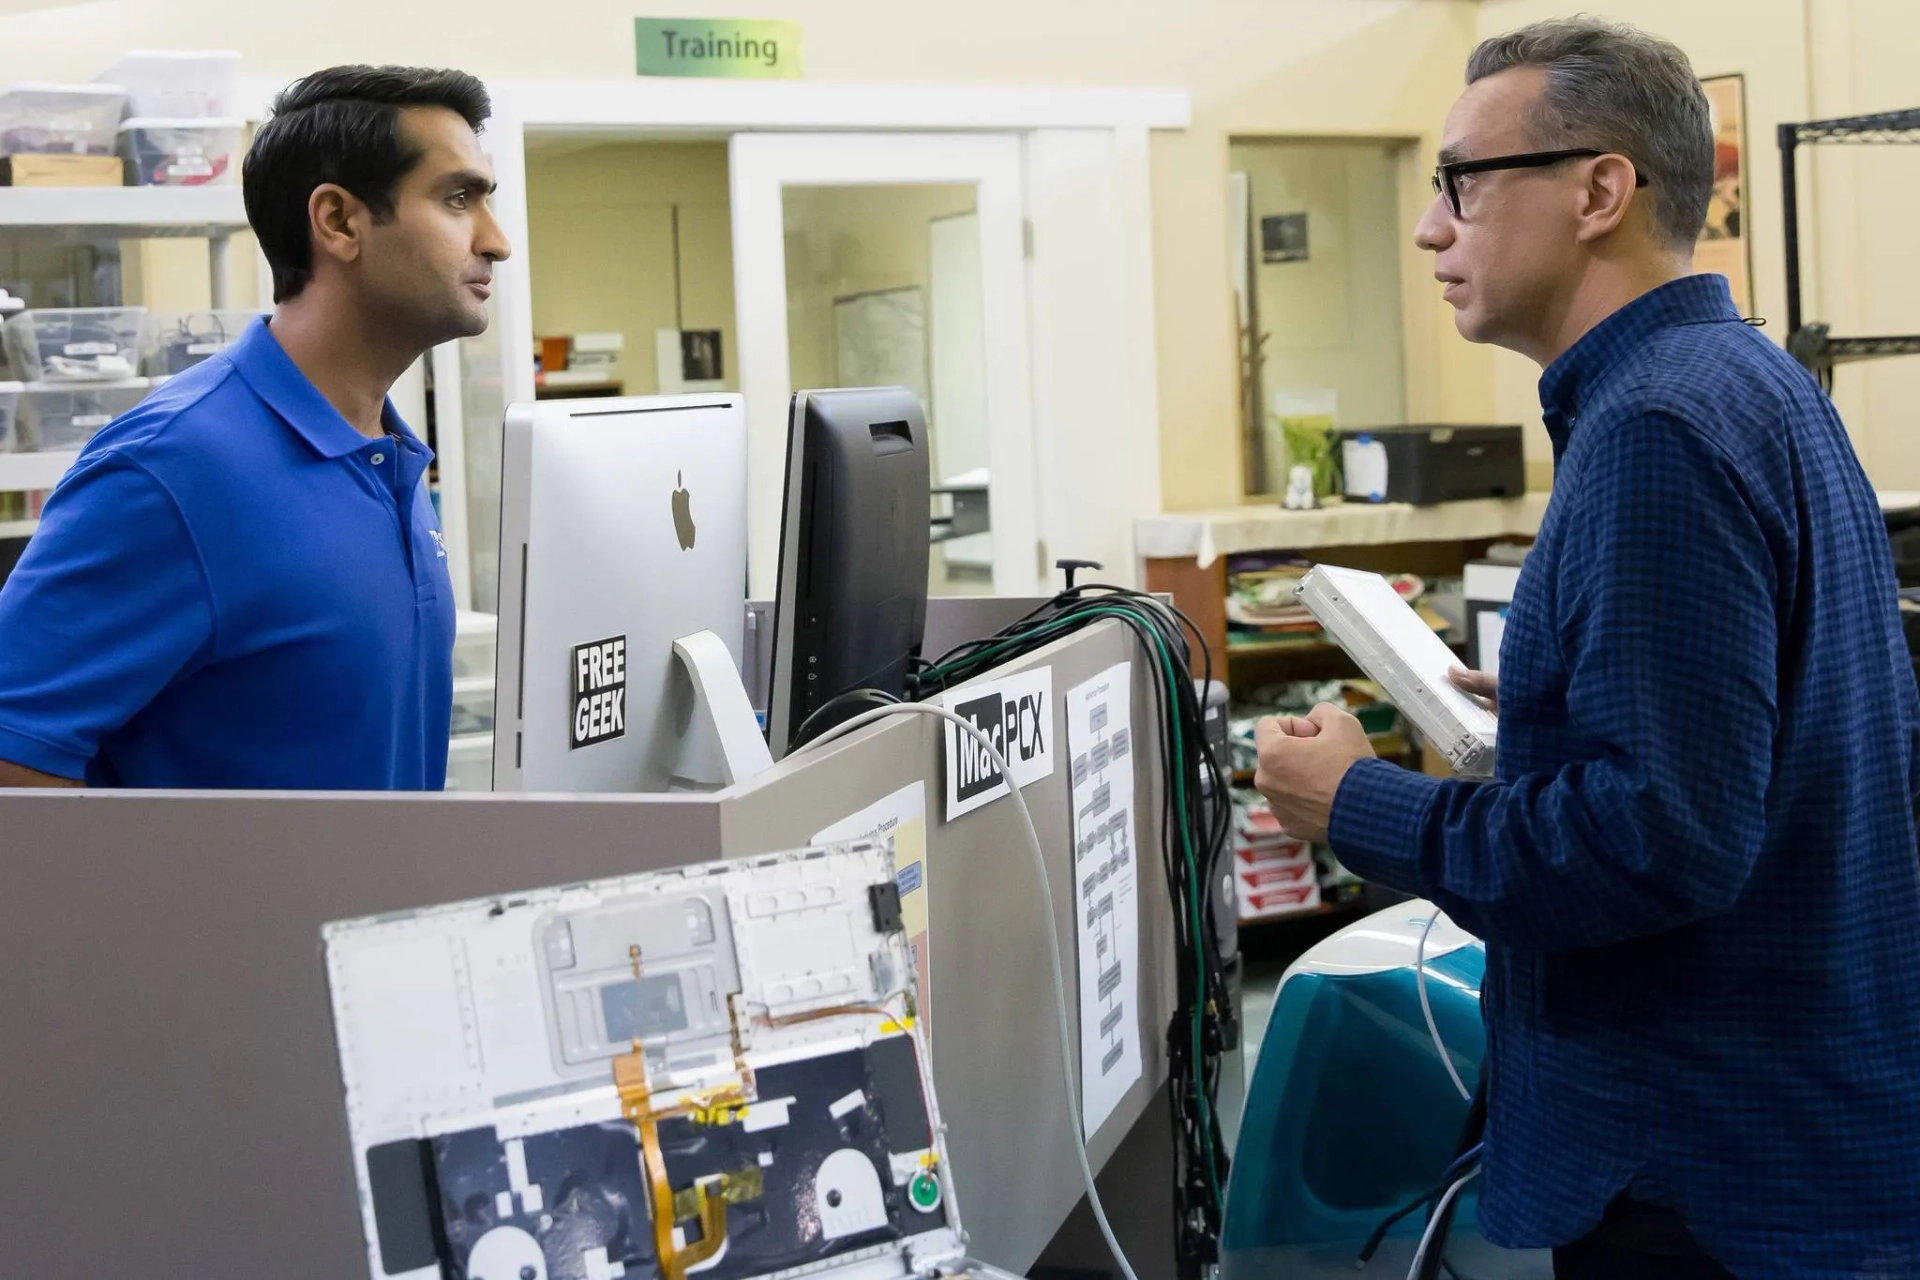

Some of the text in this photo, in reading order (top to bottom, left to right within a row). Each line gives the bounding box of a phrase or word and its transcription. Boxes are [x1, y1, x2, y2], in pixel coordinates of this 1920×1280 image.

[661, 30, 778, 67] Training
[577, 639, 625, 693] FREE
[575, 687, 625, 742] GEEK
